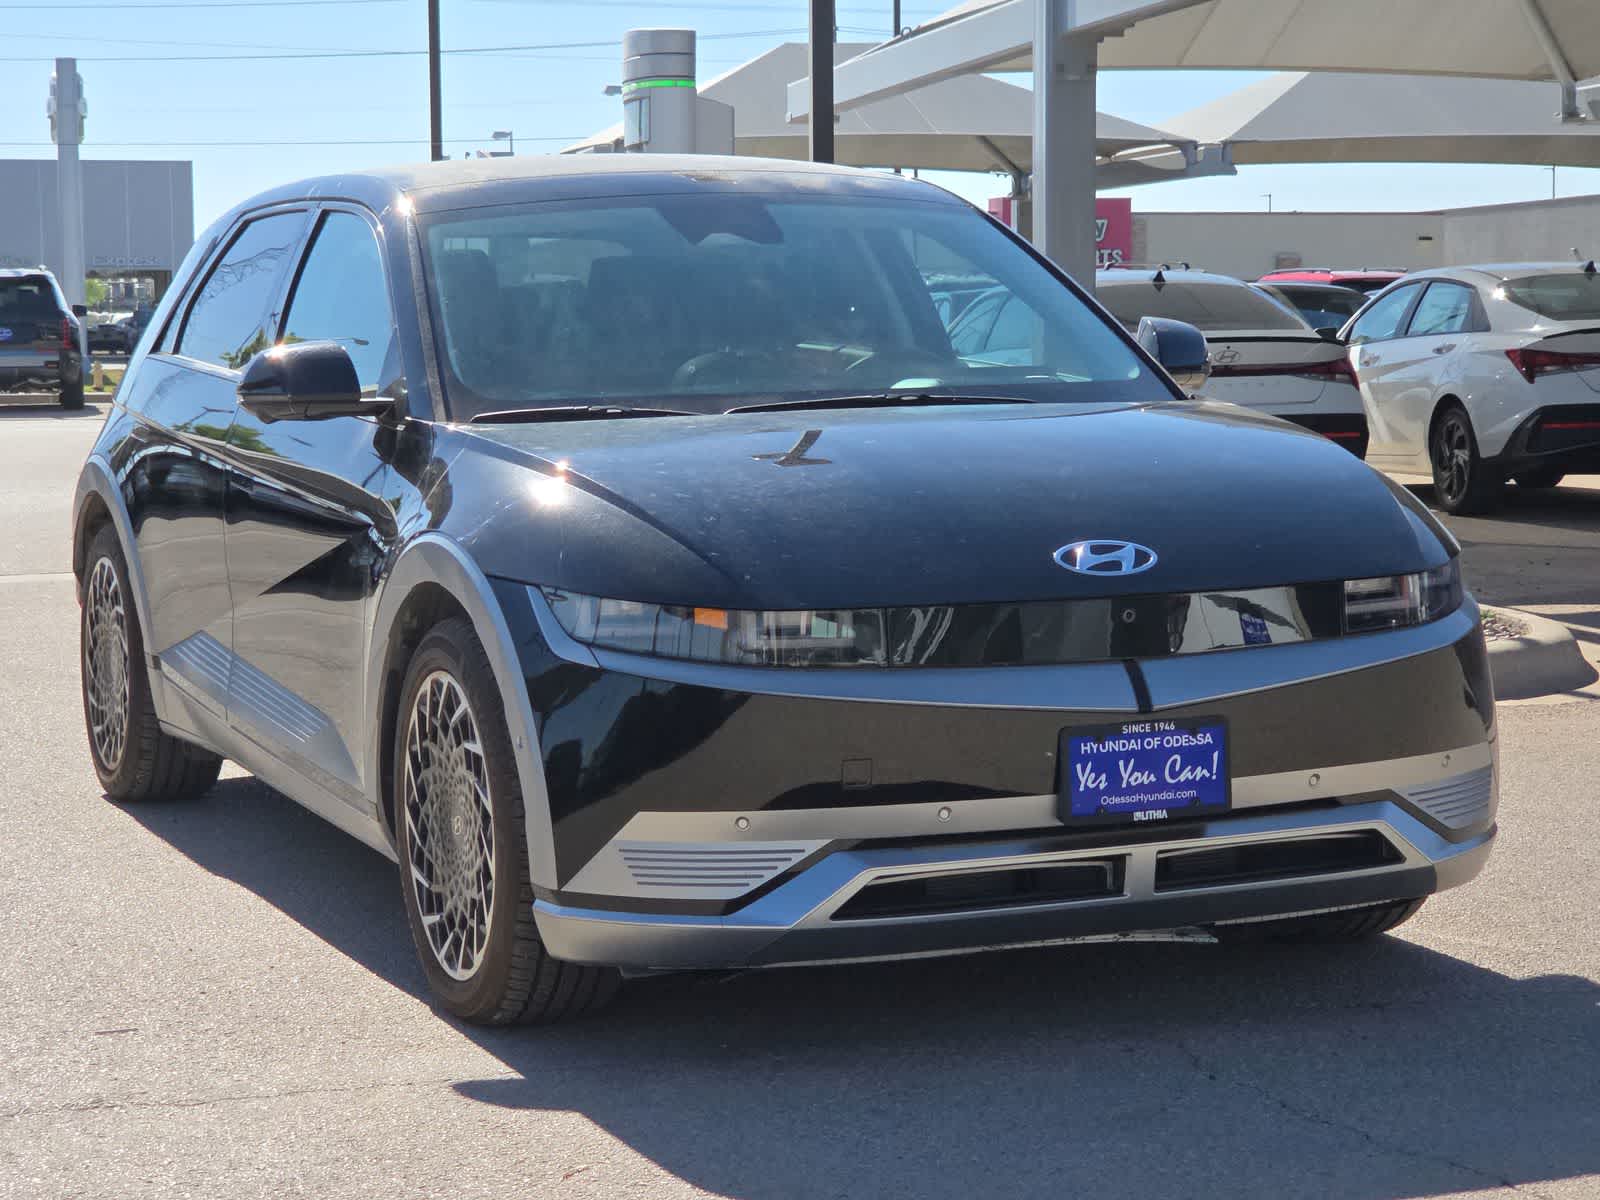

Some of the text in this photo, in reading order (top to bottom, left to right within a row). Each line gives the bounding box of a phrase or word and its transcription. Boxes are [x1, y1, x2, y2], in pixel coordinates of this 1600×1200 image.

[1122, 720, 1176, 734] SINCE 1946
[1081, 733, 1213, 755] HYUNDAI OF ODESSA
[1075, 750, 1219, 792] Yes You Can!
[1101, 789, 1197, 806] OdessaHyundai.com
[1141, 809, 1168, 821] LITHIA
